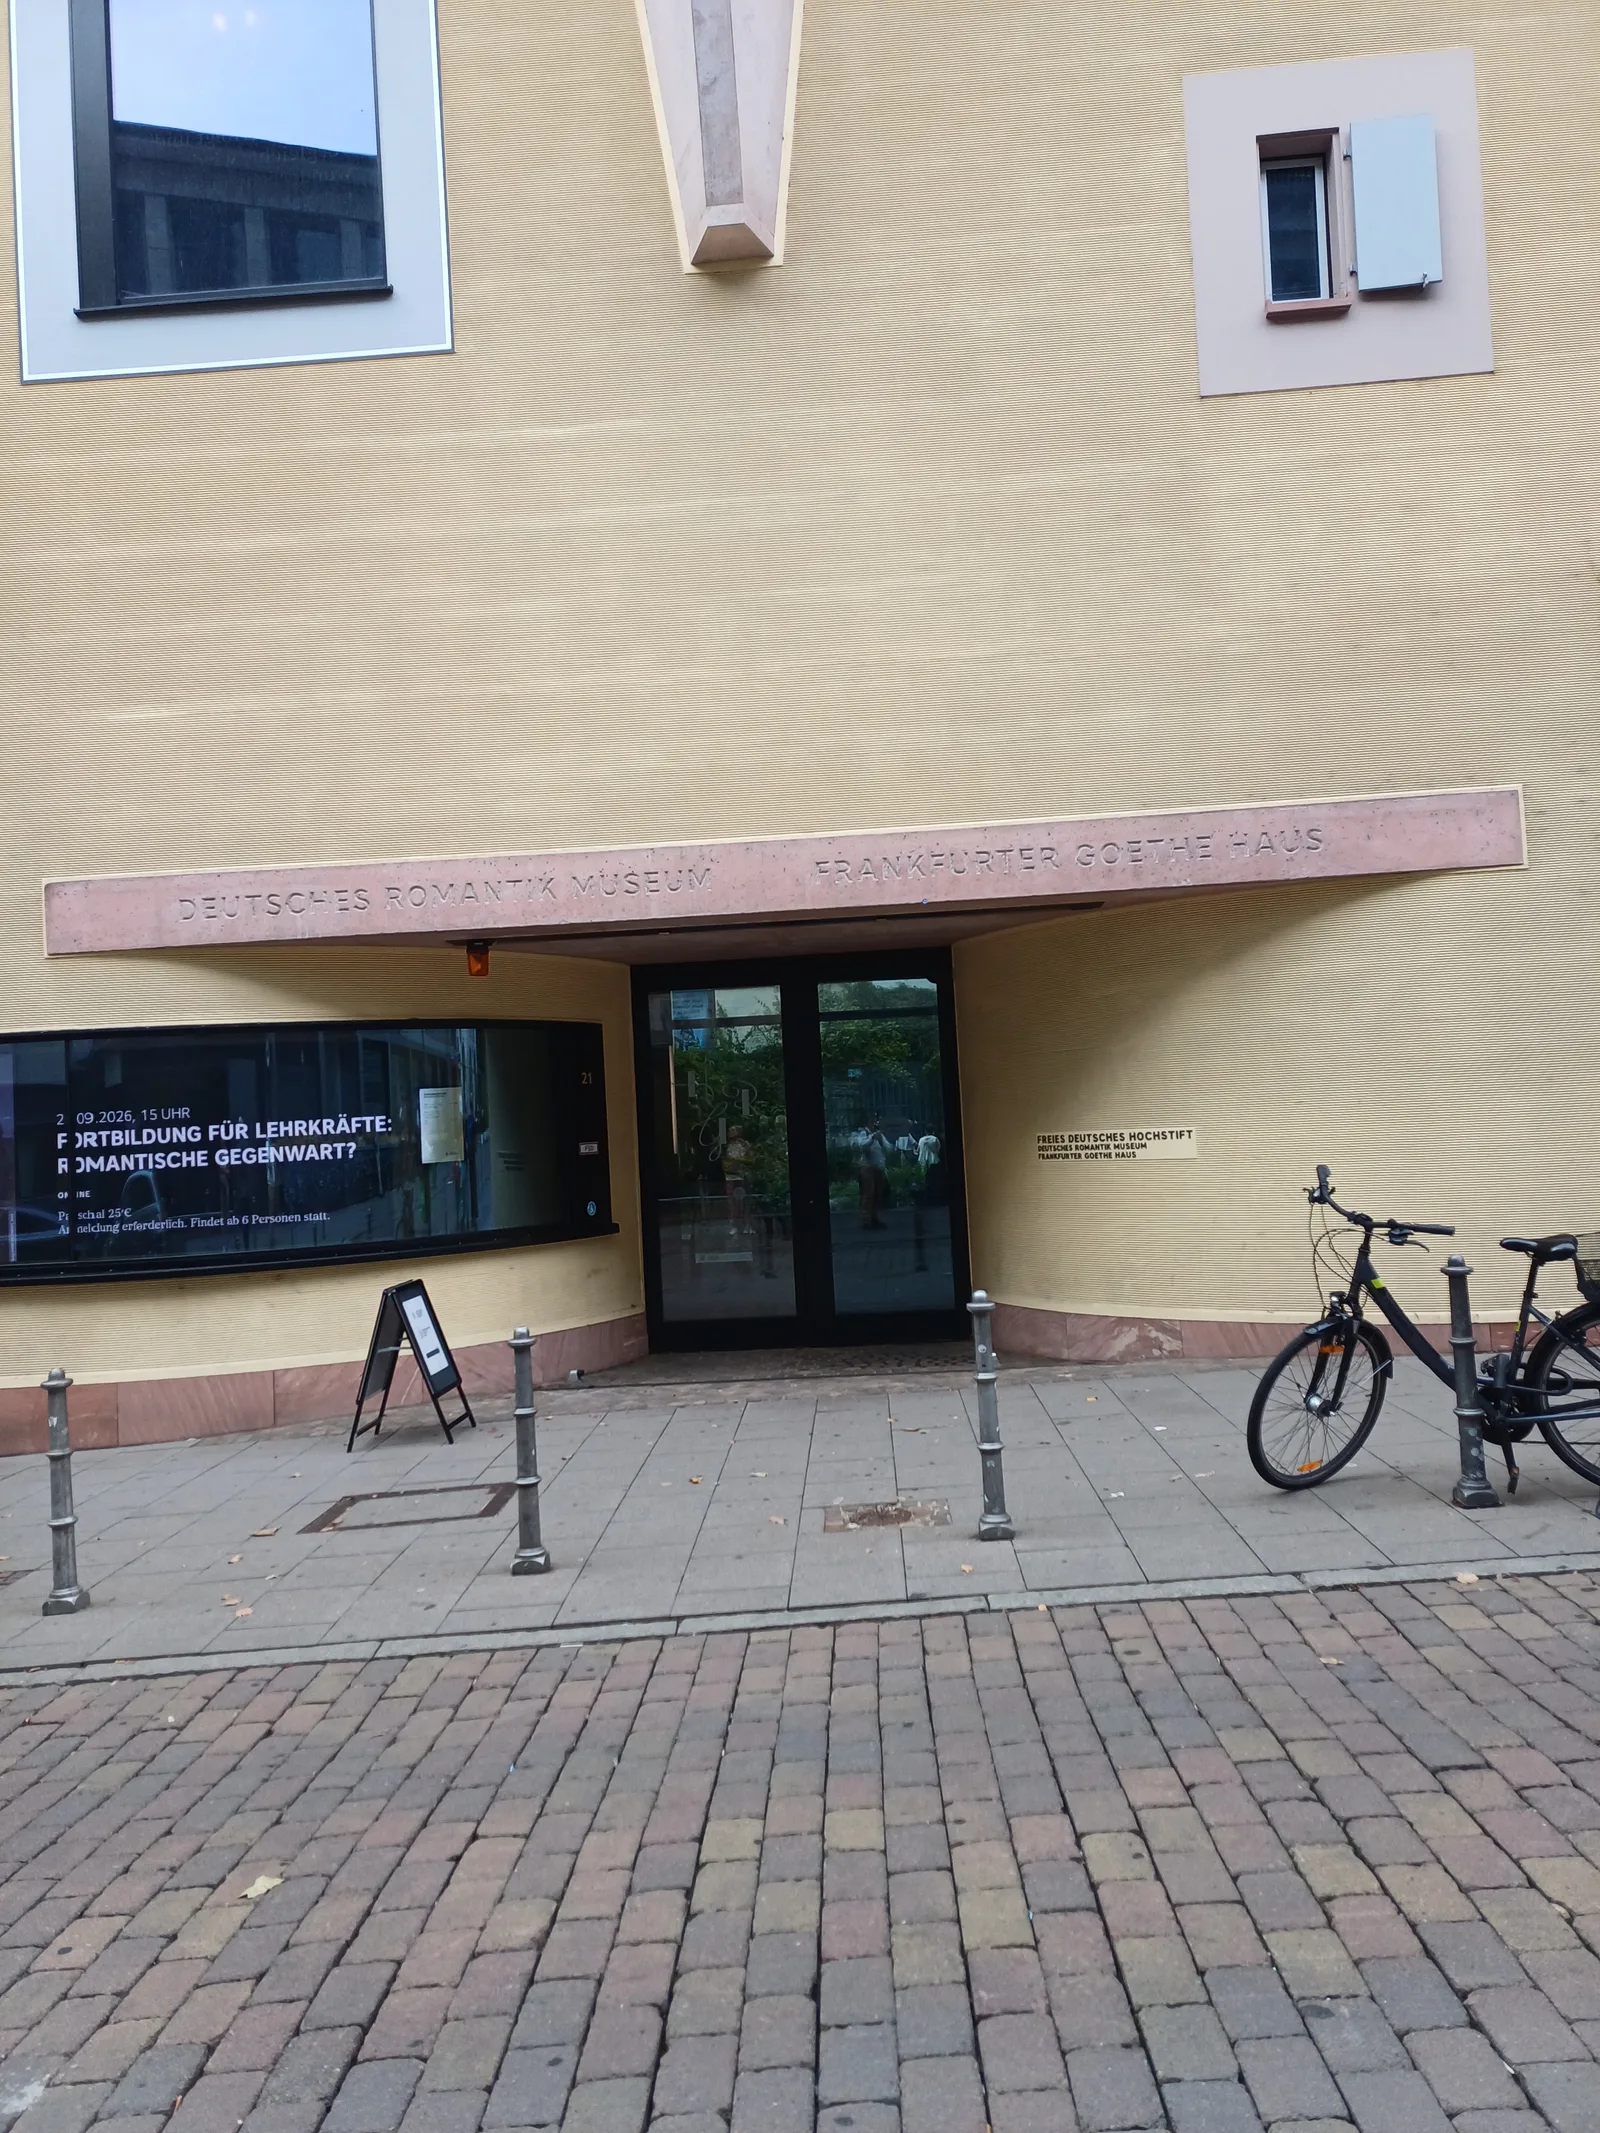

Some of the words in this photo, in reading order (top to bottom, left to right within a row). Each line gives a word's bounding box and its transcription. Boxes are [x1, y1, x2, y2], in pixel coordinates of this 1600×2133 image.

[814, 847, 1060, 885] FRANKFURTER
[1074, 836, 1212, 868] GOETHE
[1229, 828, 1325, 859] HAUS
[178, 888, 371, 923] DEUTSCHES
[385, 876, 558, 911] ROMANTIK
[571, 868, 713, 900] MUSEUM
[581, 1072, 592, 1085] 21
[141, 1109, 158, 1121] 15
[161, 1107, 191, 1120] UHR
[208, 1120, 249, 1141] FÜR
[255, 1113, 393, 1139] LEHRKRÄFTE:
[1037, 1134, 1065, 1144] FREIES
[1068, 1132, 1125, 1143] DEUTSCHES
[1129, 1130, 1193, 1141] HOCHSTIFT
[215, 1142, 357, 1166] GEGENWART?
[1037, 1144, 1073, 1152] DEUTSCHES
[1075, 1143, 1111, 1151] ROMANTIK
[1113, 1142, 1147, 1150] MUSEUM
[1038, 1152, 1082, 1160] FRANKFURTER
[1084, 1151, 1112, 1159] GOETHE
[57, 1190, 91, 1199] ONINE
[58, 1209, 105, 1221] Paschal
[190, 1216, 224, 1228] Findet
[227, 1216, 239, 1226] ab
[242, 1215, 249, 1225] 6
[252, 1213, 301, 1224] Personen
